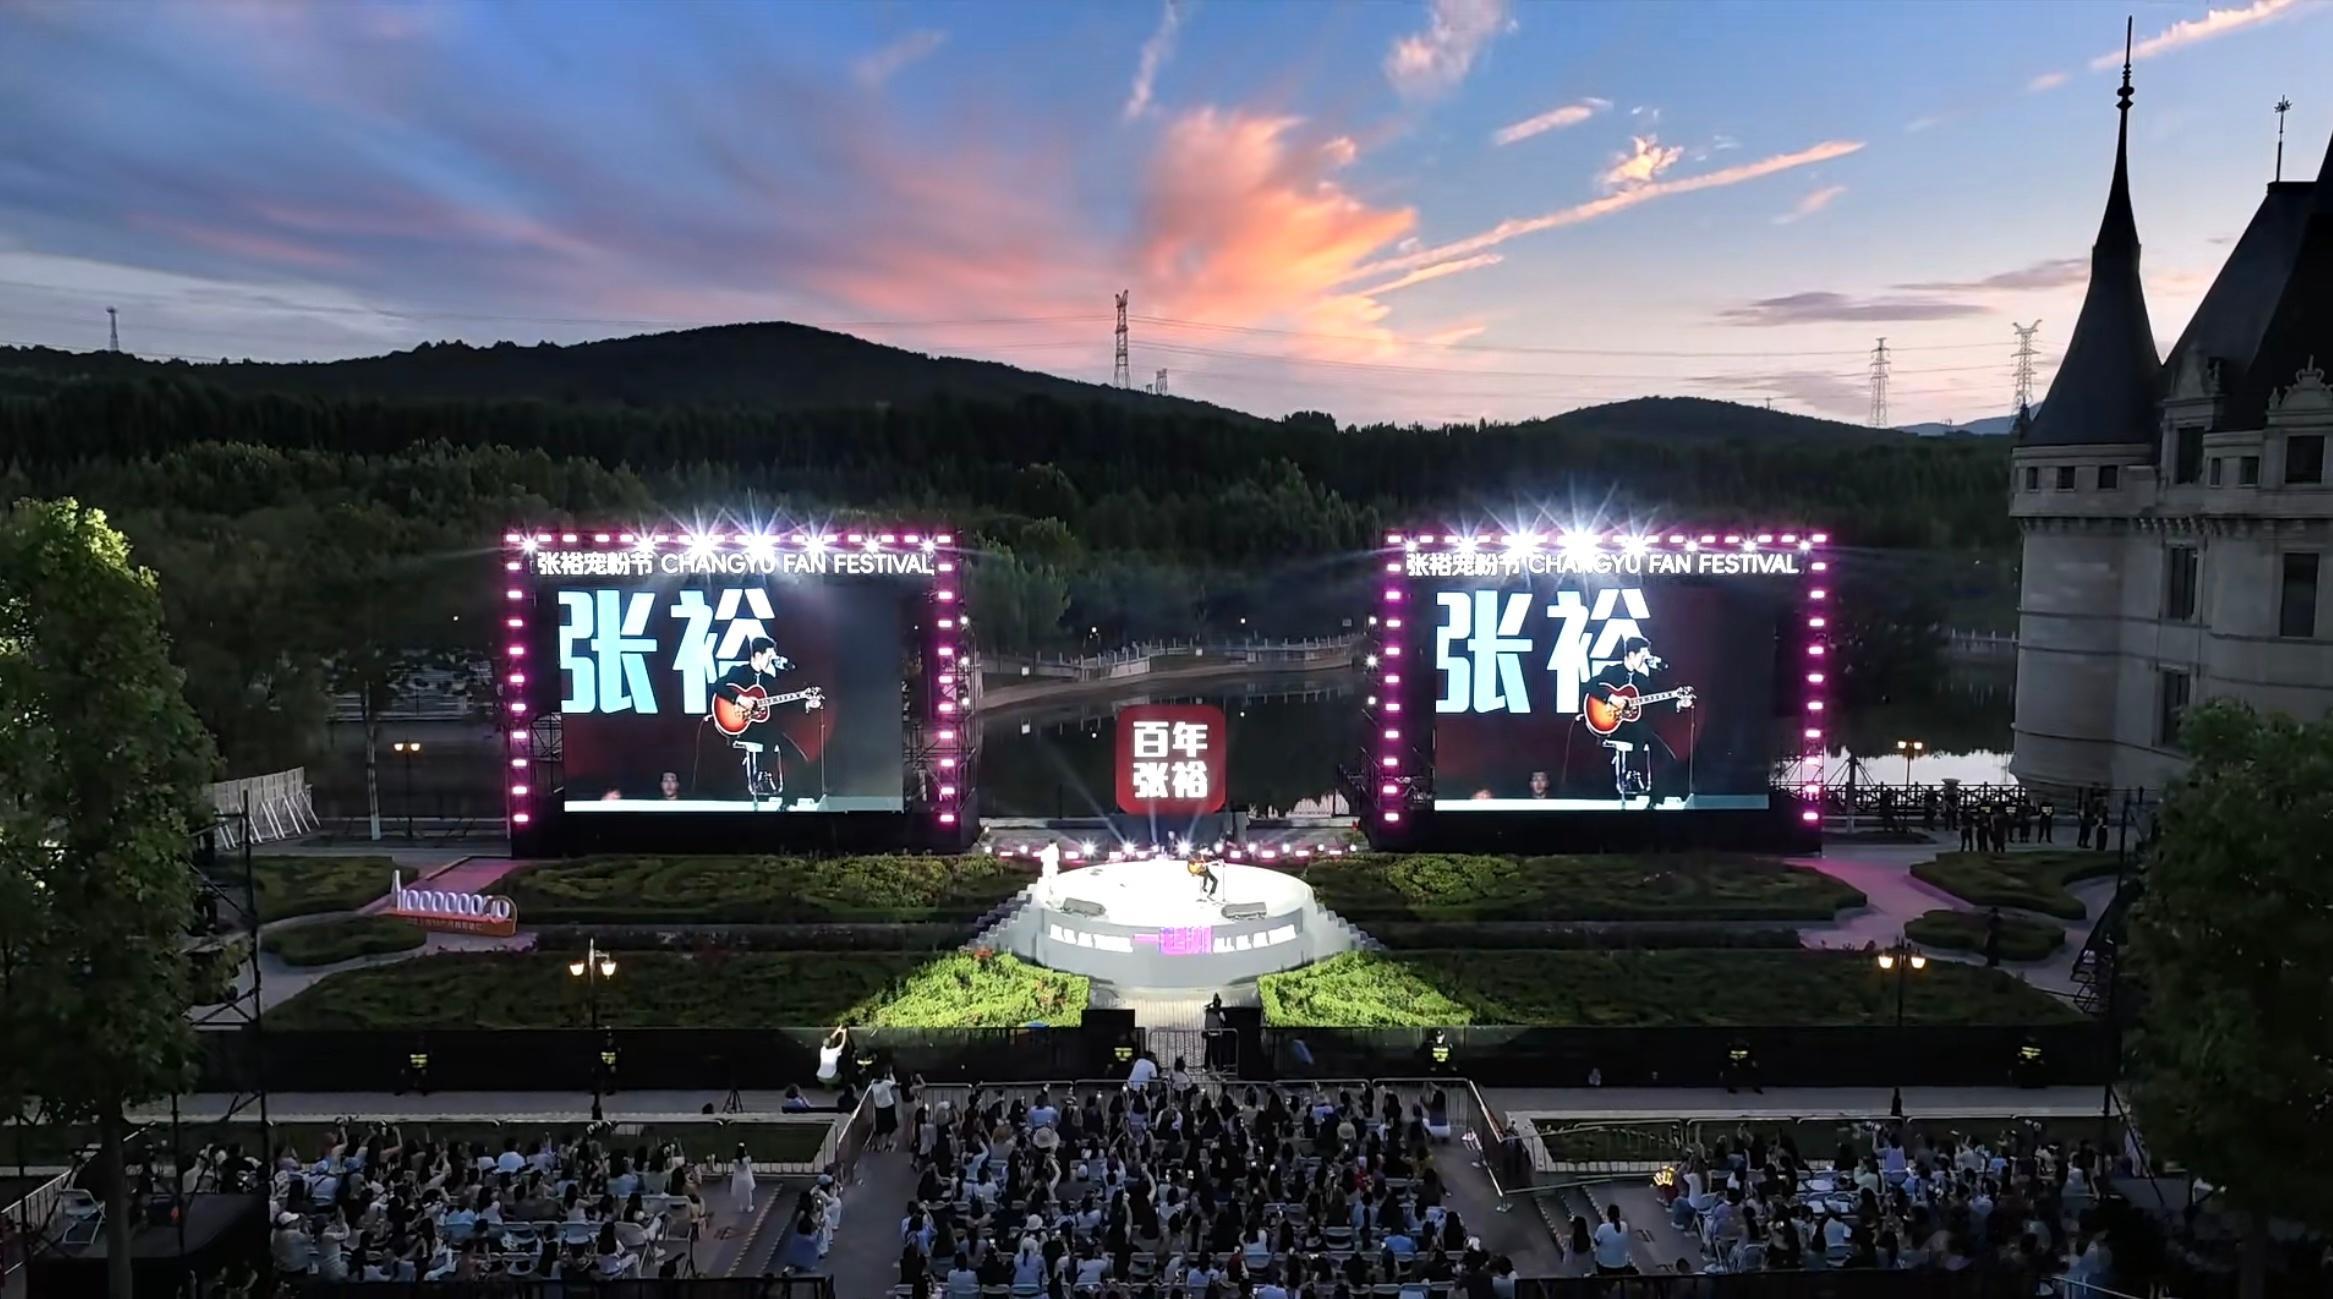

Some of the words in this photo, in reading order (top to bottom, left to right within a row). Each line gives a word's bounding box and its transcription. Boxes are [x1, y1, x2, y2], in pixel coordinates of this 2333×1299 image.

[537, 552, 653, 575] 张裕宠粉节
[661, 554, 776, 575] CHANGYU
[784, 554, 826, 574] FAN
[834, 553, 934, 575] FESTIVAL
[1407, 553, 1520, 576] 张裕宠粉节
[1529, 554, 1640, 575] CHANGYU
[1649, 554, 1691, 575] FAN
[1699, 554, 1799, 575] FESTIVAL
[558, 588, 775, 714] 张裕
[1436, 588, 1651, 714] 张裕
[1133, 721, 1208, 758] 百年
[1133, 762, 1208, 798] 张裕
